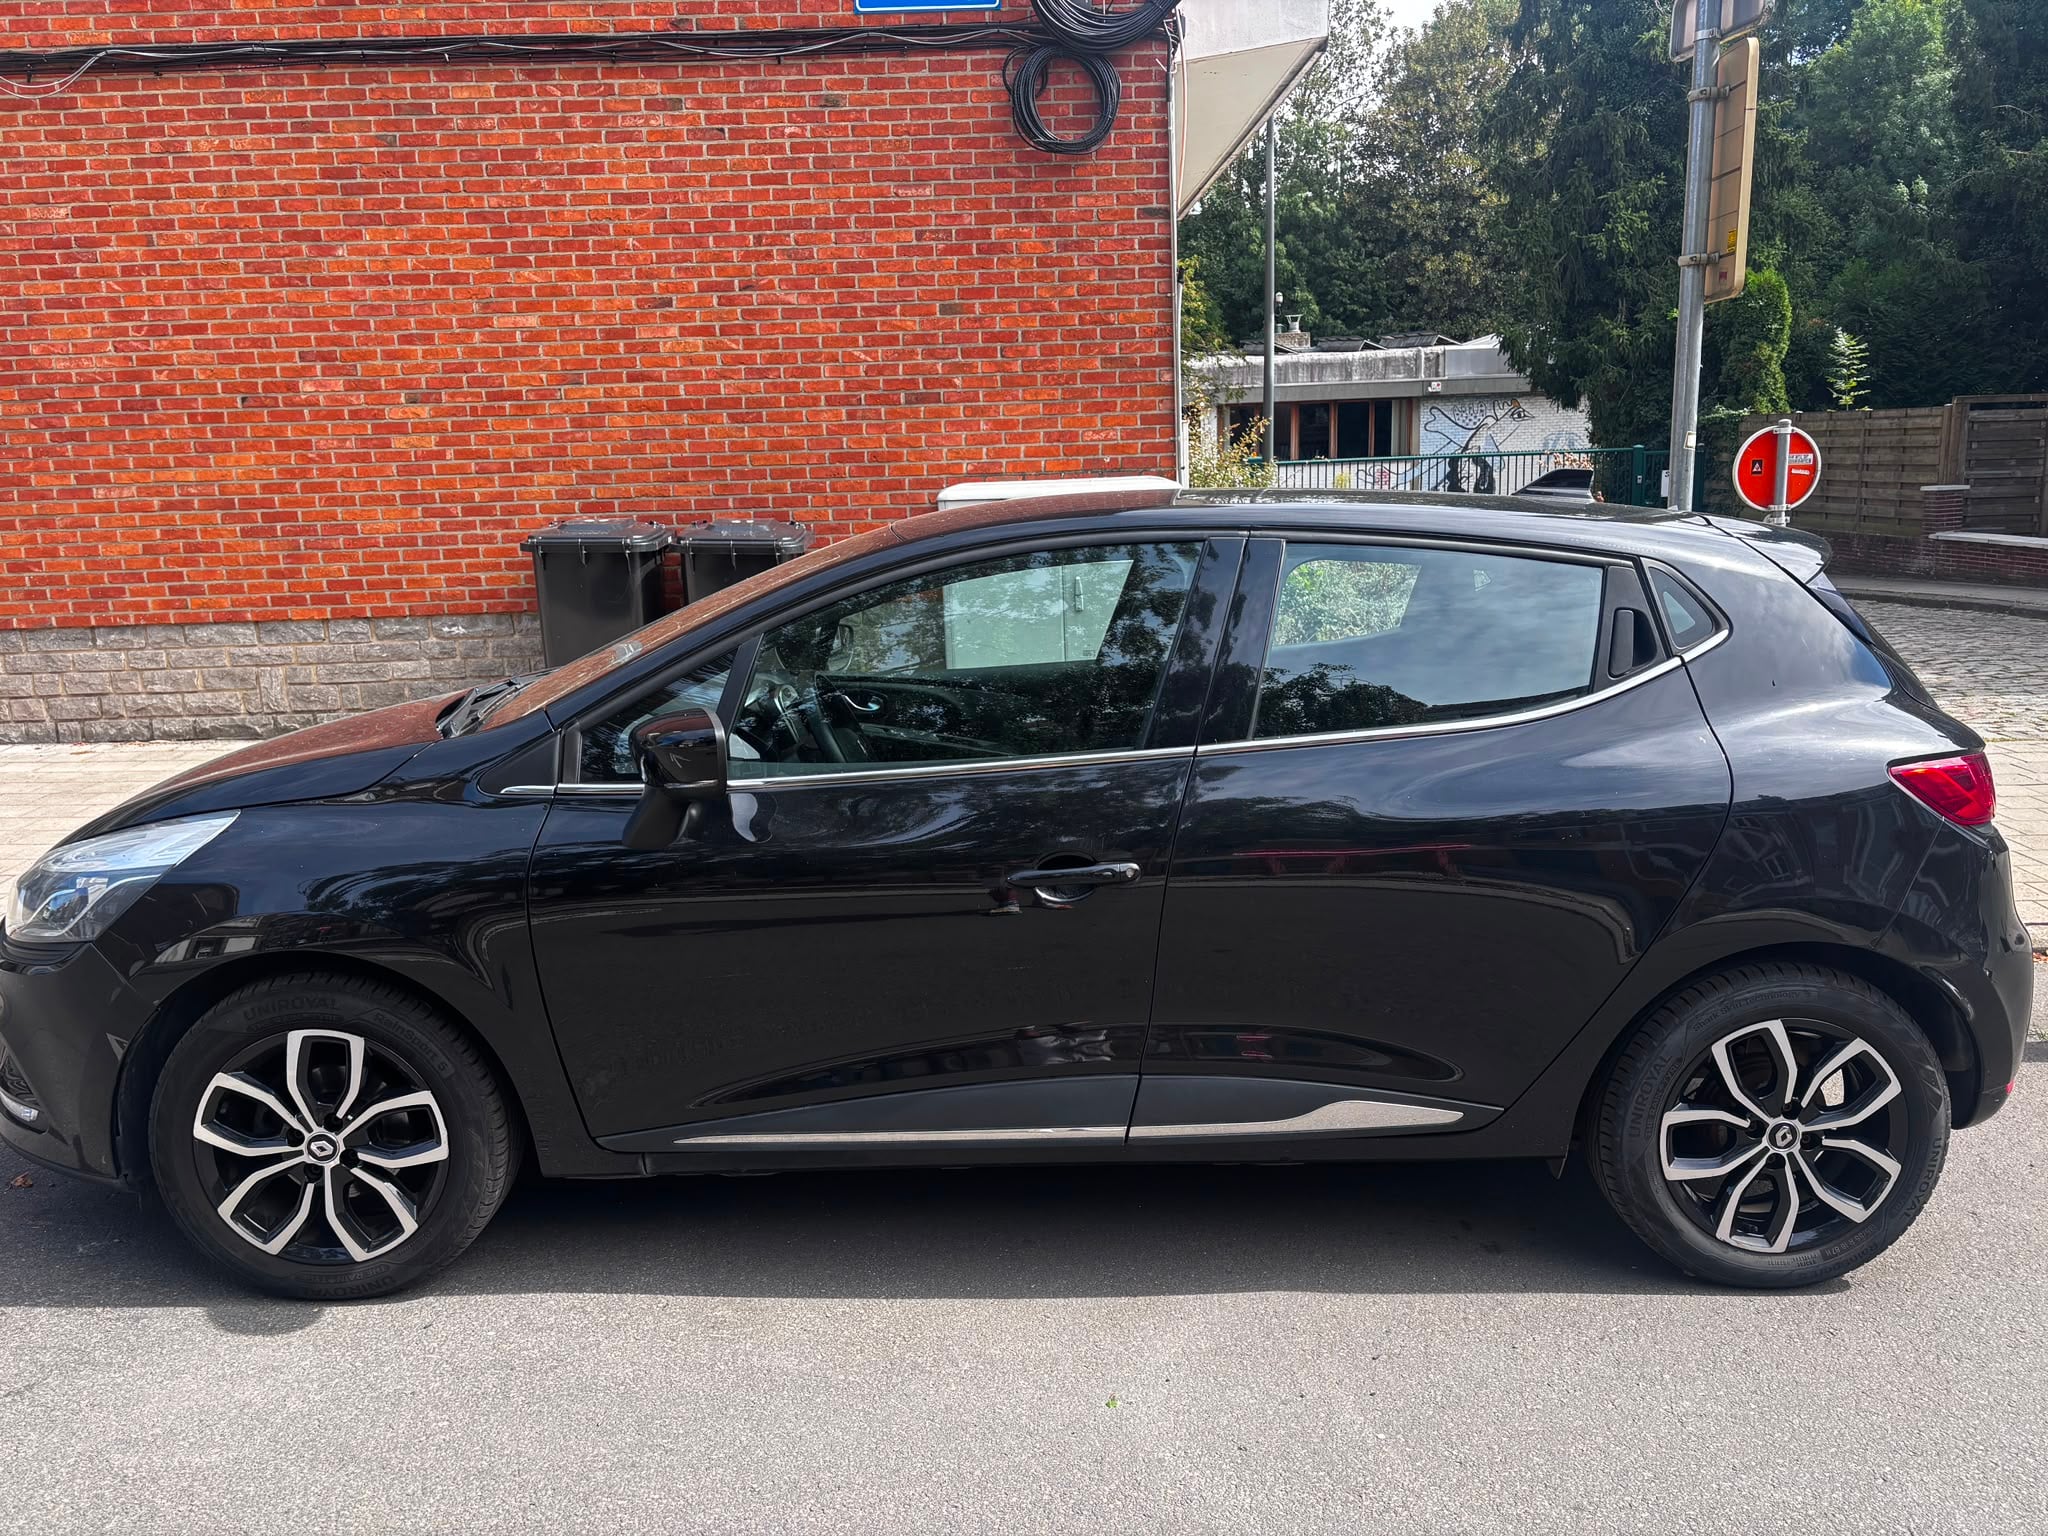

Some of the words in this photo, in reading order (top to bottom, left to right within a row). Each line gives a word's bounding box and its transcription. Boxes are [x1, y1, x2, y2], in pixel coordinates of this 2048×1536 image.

[243, 997, 337, 1021] UNIROYAL
[1692, 1009, 1719, 1032] Shark
[1628, 1054, 1672, 1137] UNIROYAL
[1902, 1137, 1942, 1218] UNIROYAL
